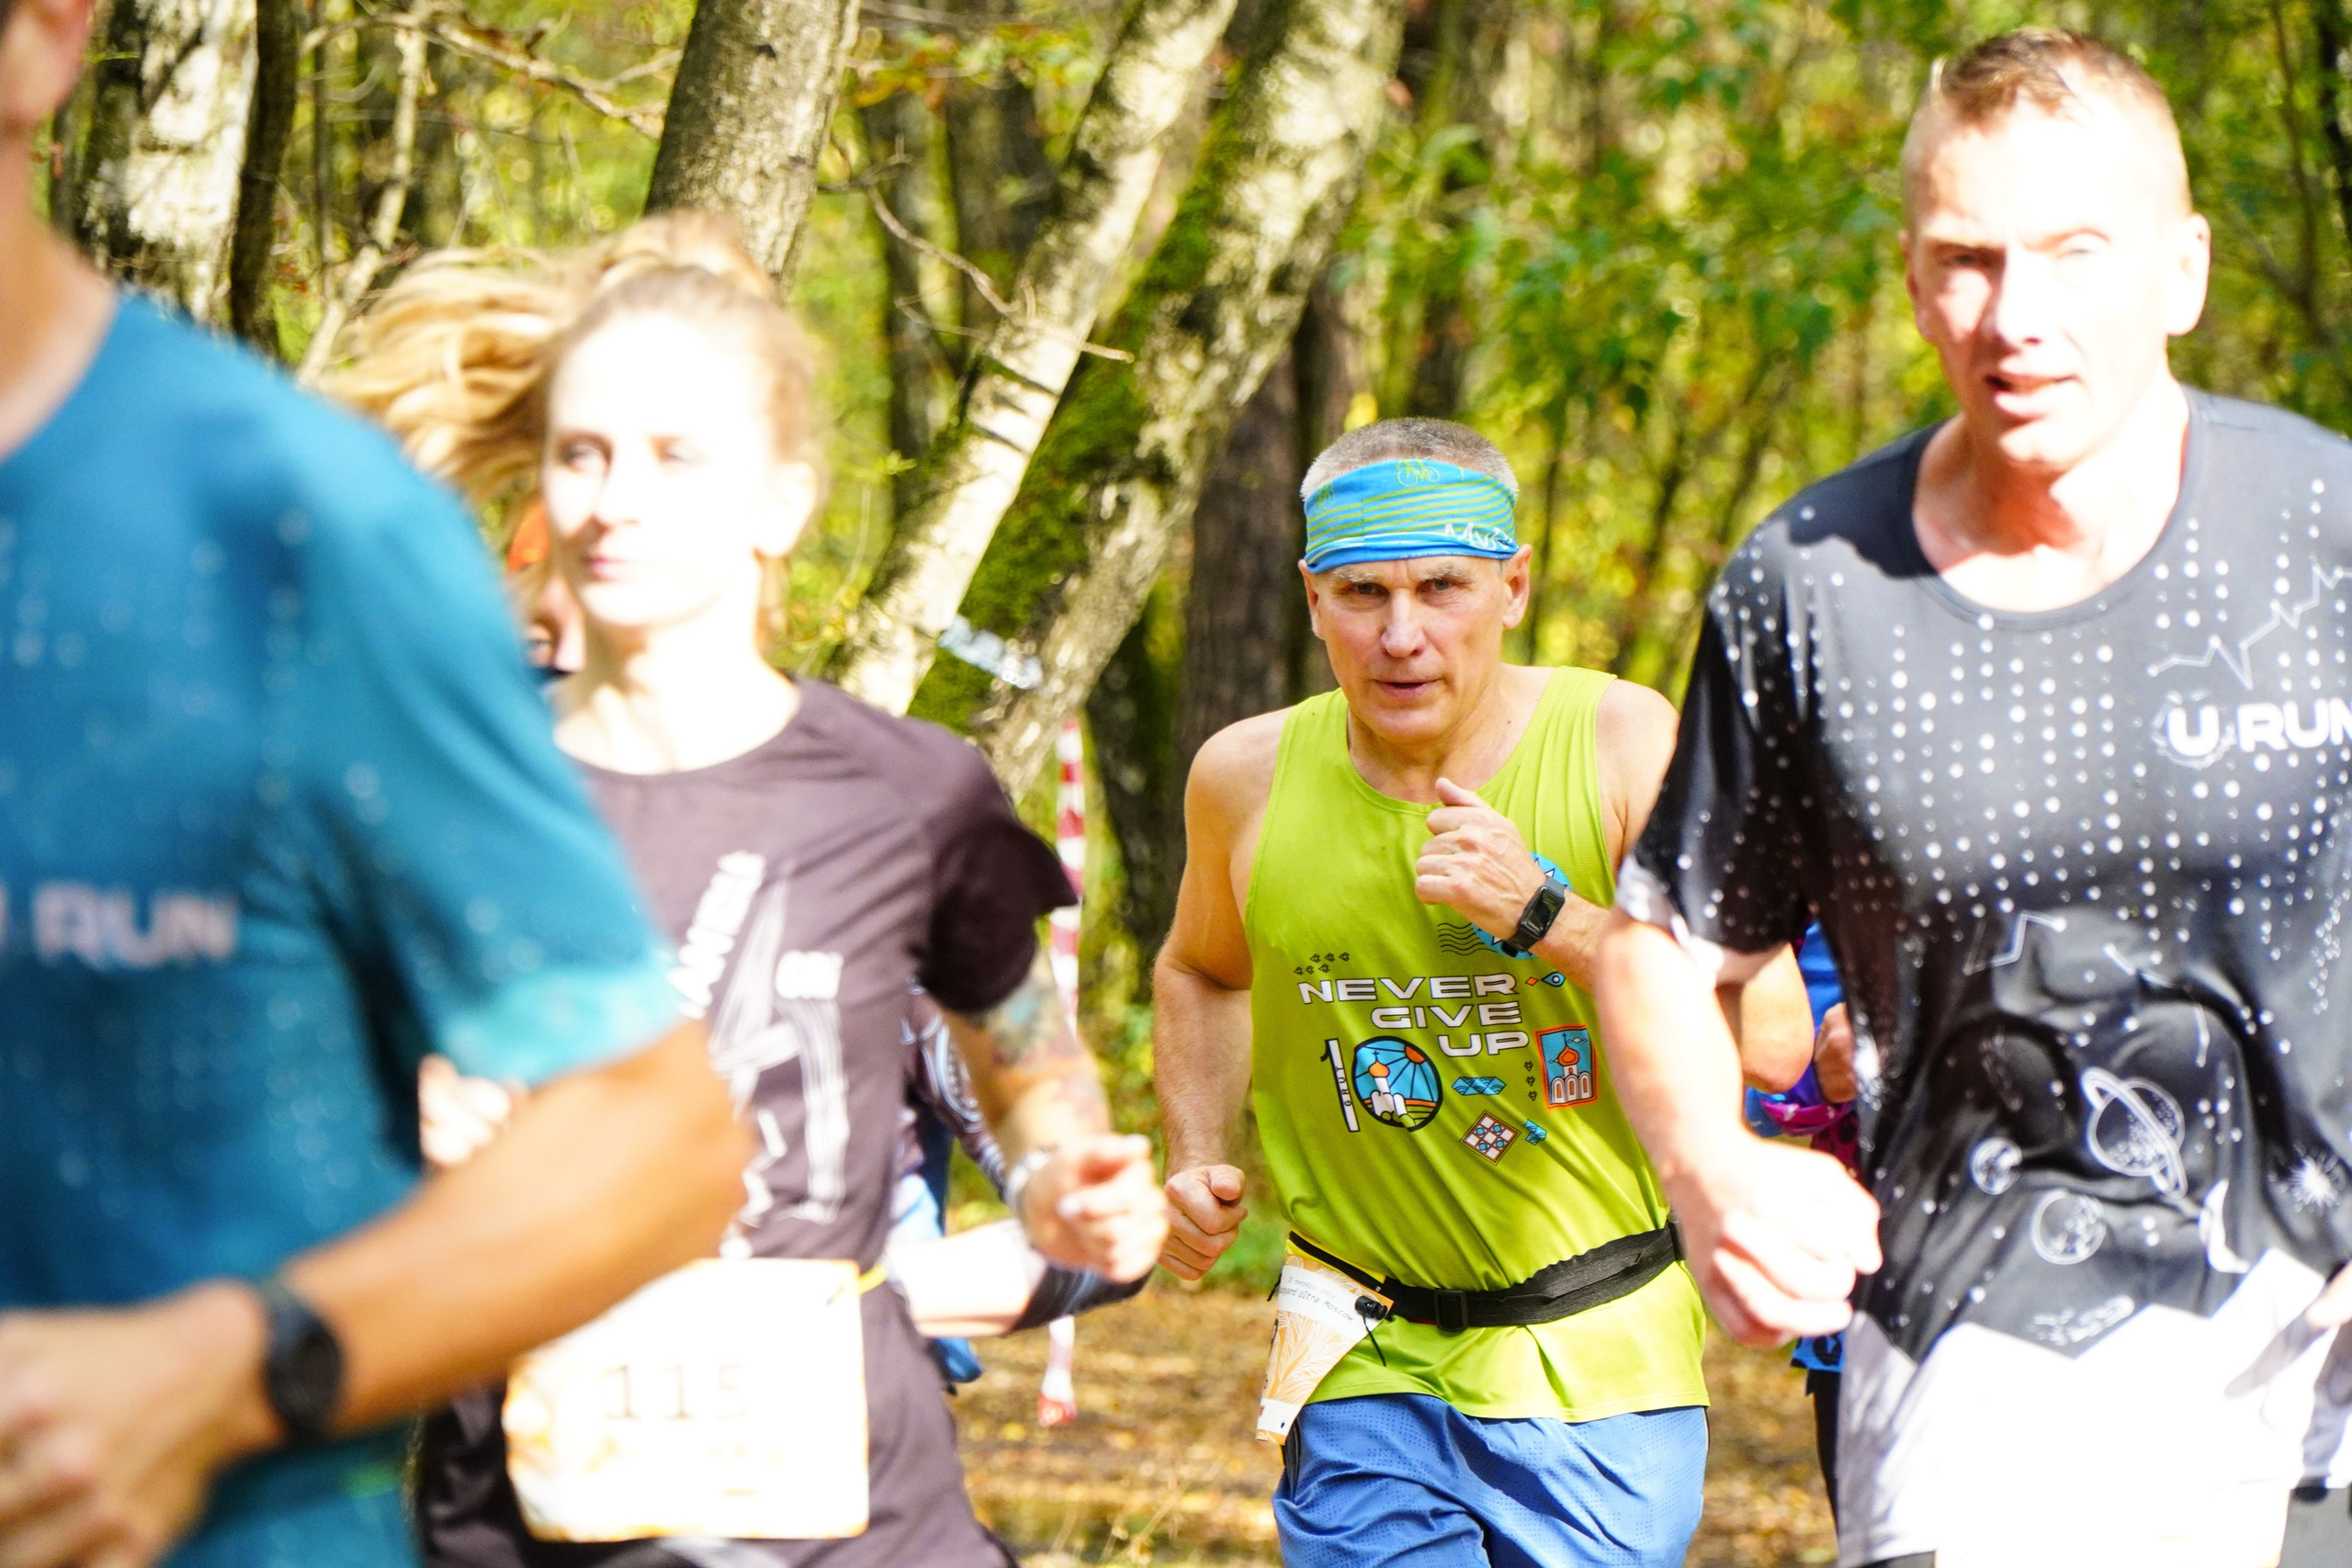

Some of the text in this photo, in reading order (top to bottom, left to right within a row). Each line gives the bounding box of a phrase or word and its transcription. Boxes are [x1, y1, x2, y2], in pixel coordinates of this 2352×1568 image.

[1297, 973, 1519, 1005] NEVER
[1371, 1000, 1522, 1029] GIVE
[1437, 1031, 1530, 1057] UP
[1337, 1066, 1352, 1108] GRUT
[1298, 1288, 1320, 1303] Ultra
[1324, 1301, 1354, 1321] Moscow
[599, 1363, 748, 1423] 115
